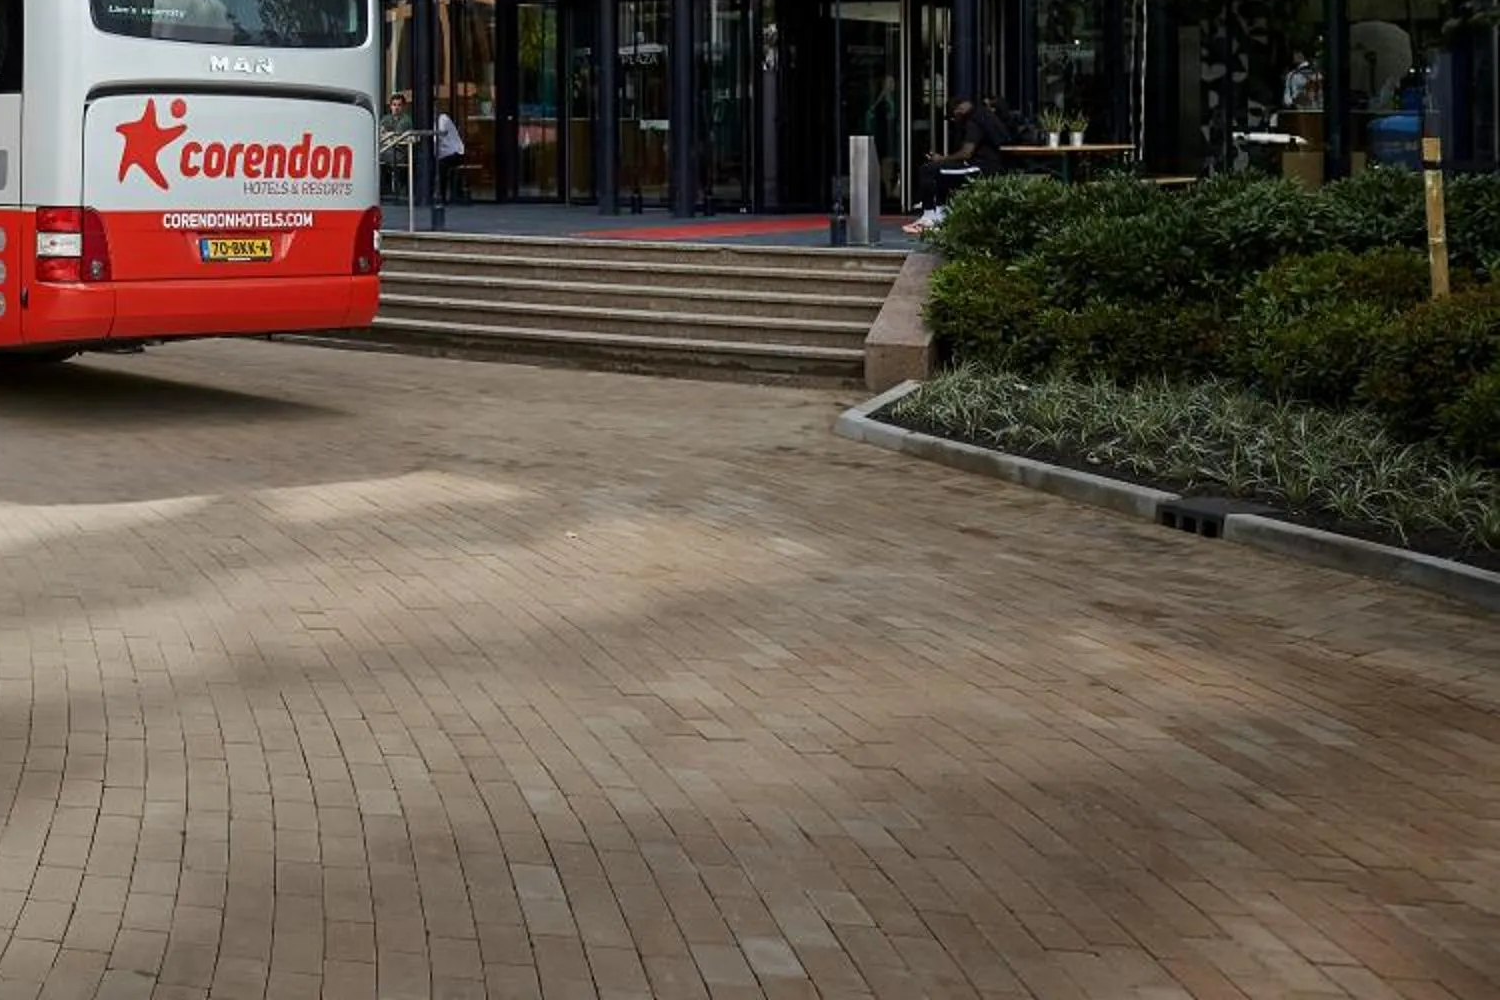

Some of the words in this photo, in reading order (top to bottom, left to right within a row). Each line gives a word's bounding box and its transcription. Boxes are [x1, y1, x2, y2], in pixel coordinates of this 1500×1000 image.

[208, 55, 275, 74] MAN
[180, 132, 353, 180] corendon
[243, 181, 289, 195] HOTELS
[290, 183, 299, 195] &
[301, 182, 353, 196] RESORTS
[163, 212, 313, 228] CORENDONHOTELS.COM
